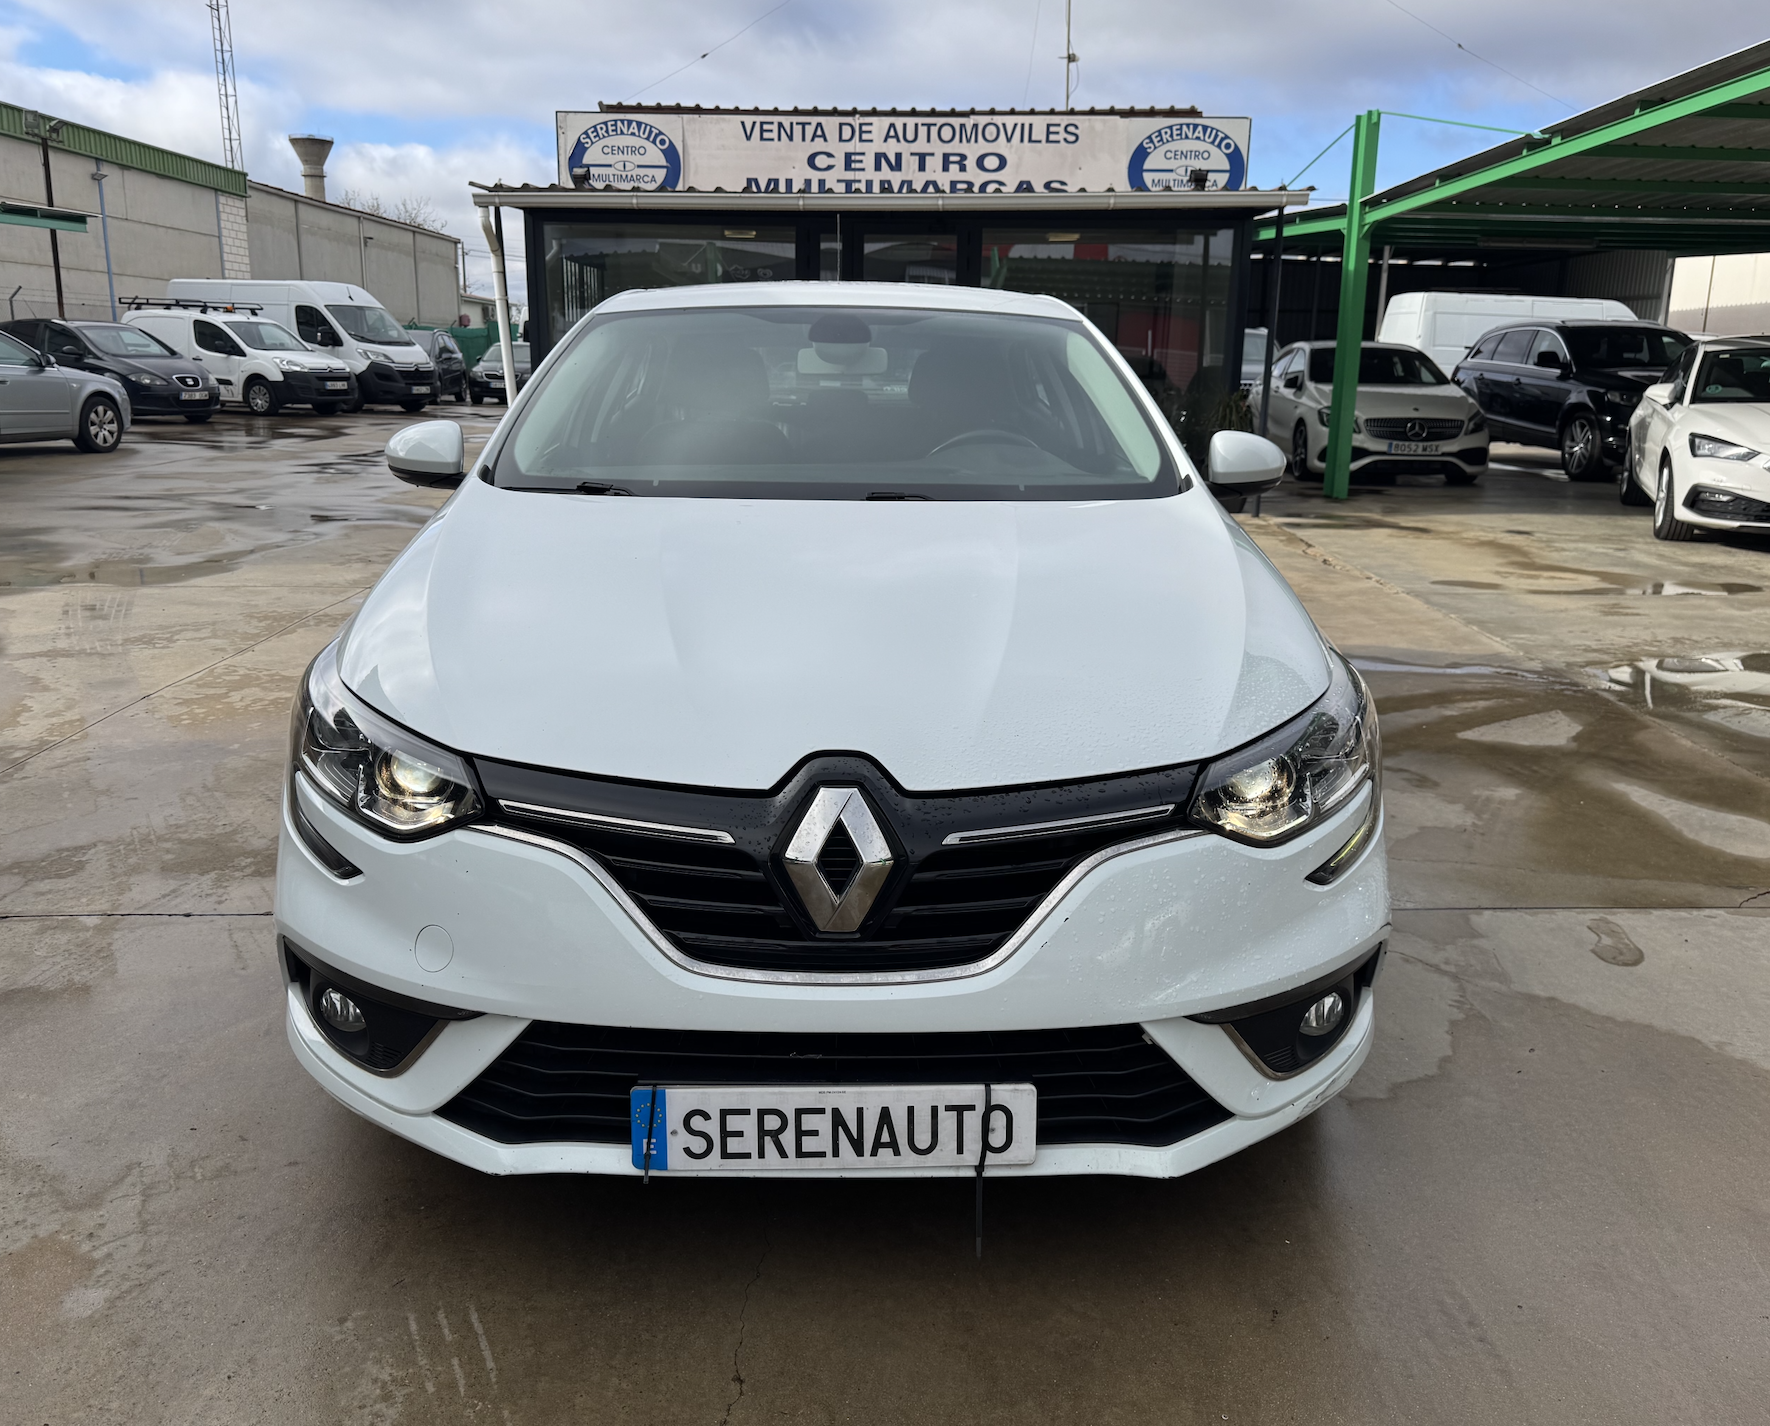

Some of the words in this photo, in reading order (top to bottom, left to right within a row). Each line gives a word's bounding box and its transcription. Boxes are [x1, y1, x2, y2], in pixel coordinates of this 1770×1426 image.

[580, 120, 670, 150] SERENAUTO
[740, 120, 828, 142] VENTA
[838, 122, 874, 143] DE
[883, 122, 1080, 144] AUTOMOVILES
[1142, 124, 1235, 154] SERENAUTO
[602, 145, 647, 156] CENTRO
[1164, 149, 1211, 161] CENTRO
[807, 151, 1007, 173] CENTRO
[592, 173, 657, 184] MULTIMARCA
[1151, 178, 1218, 189] MULTIMACA
[1393, 443, 1419, 453] 8052
[682, 1104, 1014, 1160] SERENAUTO
